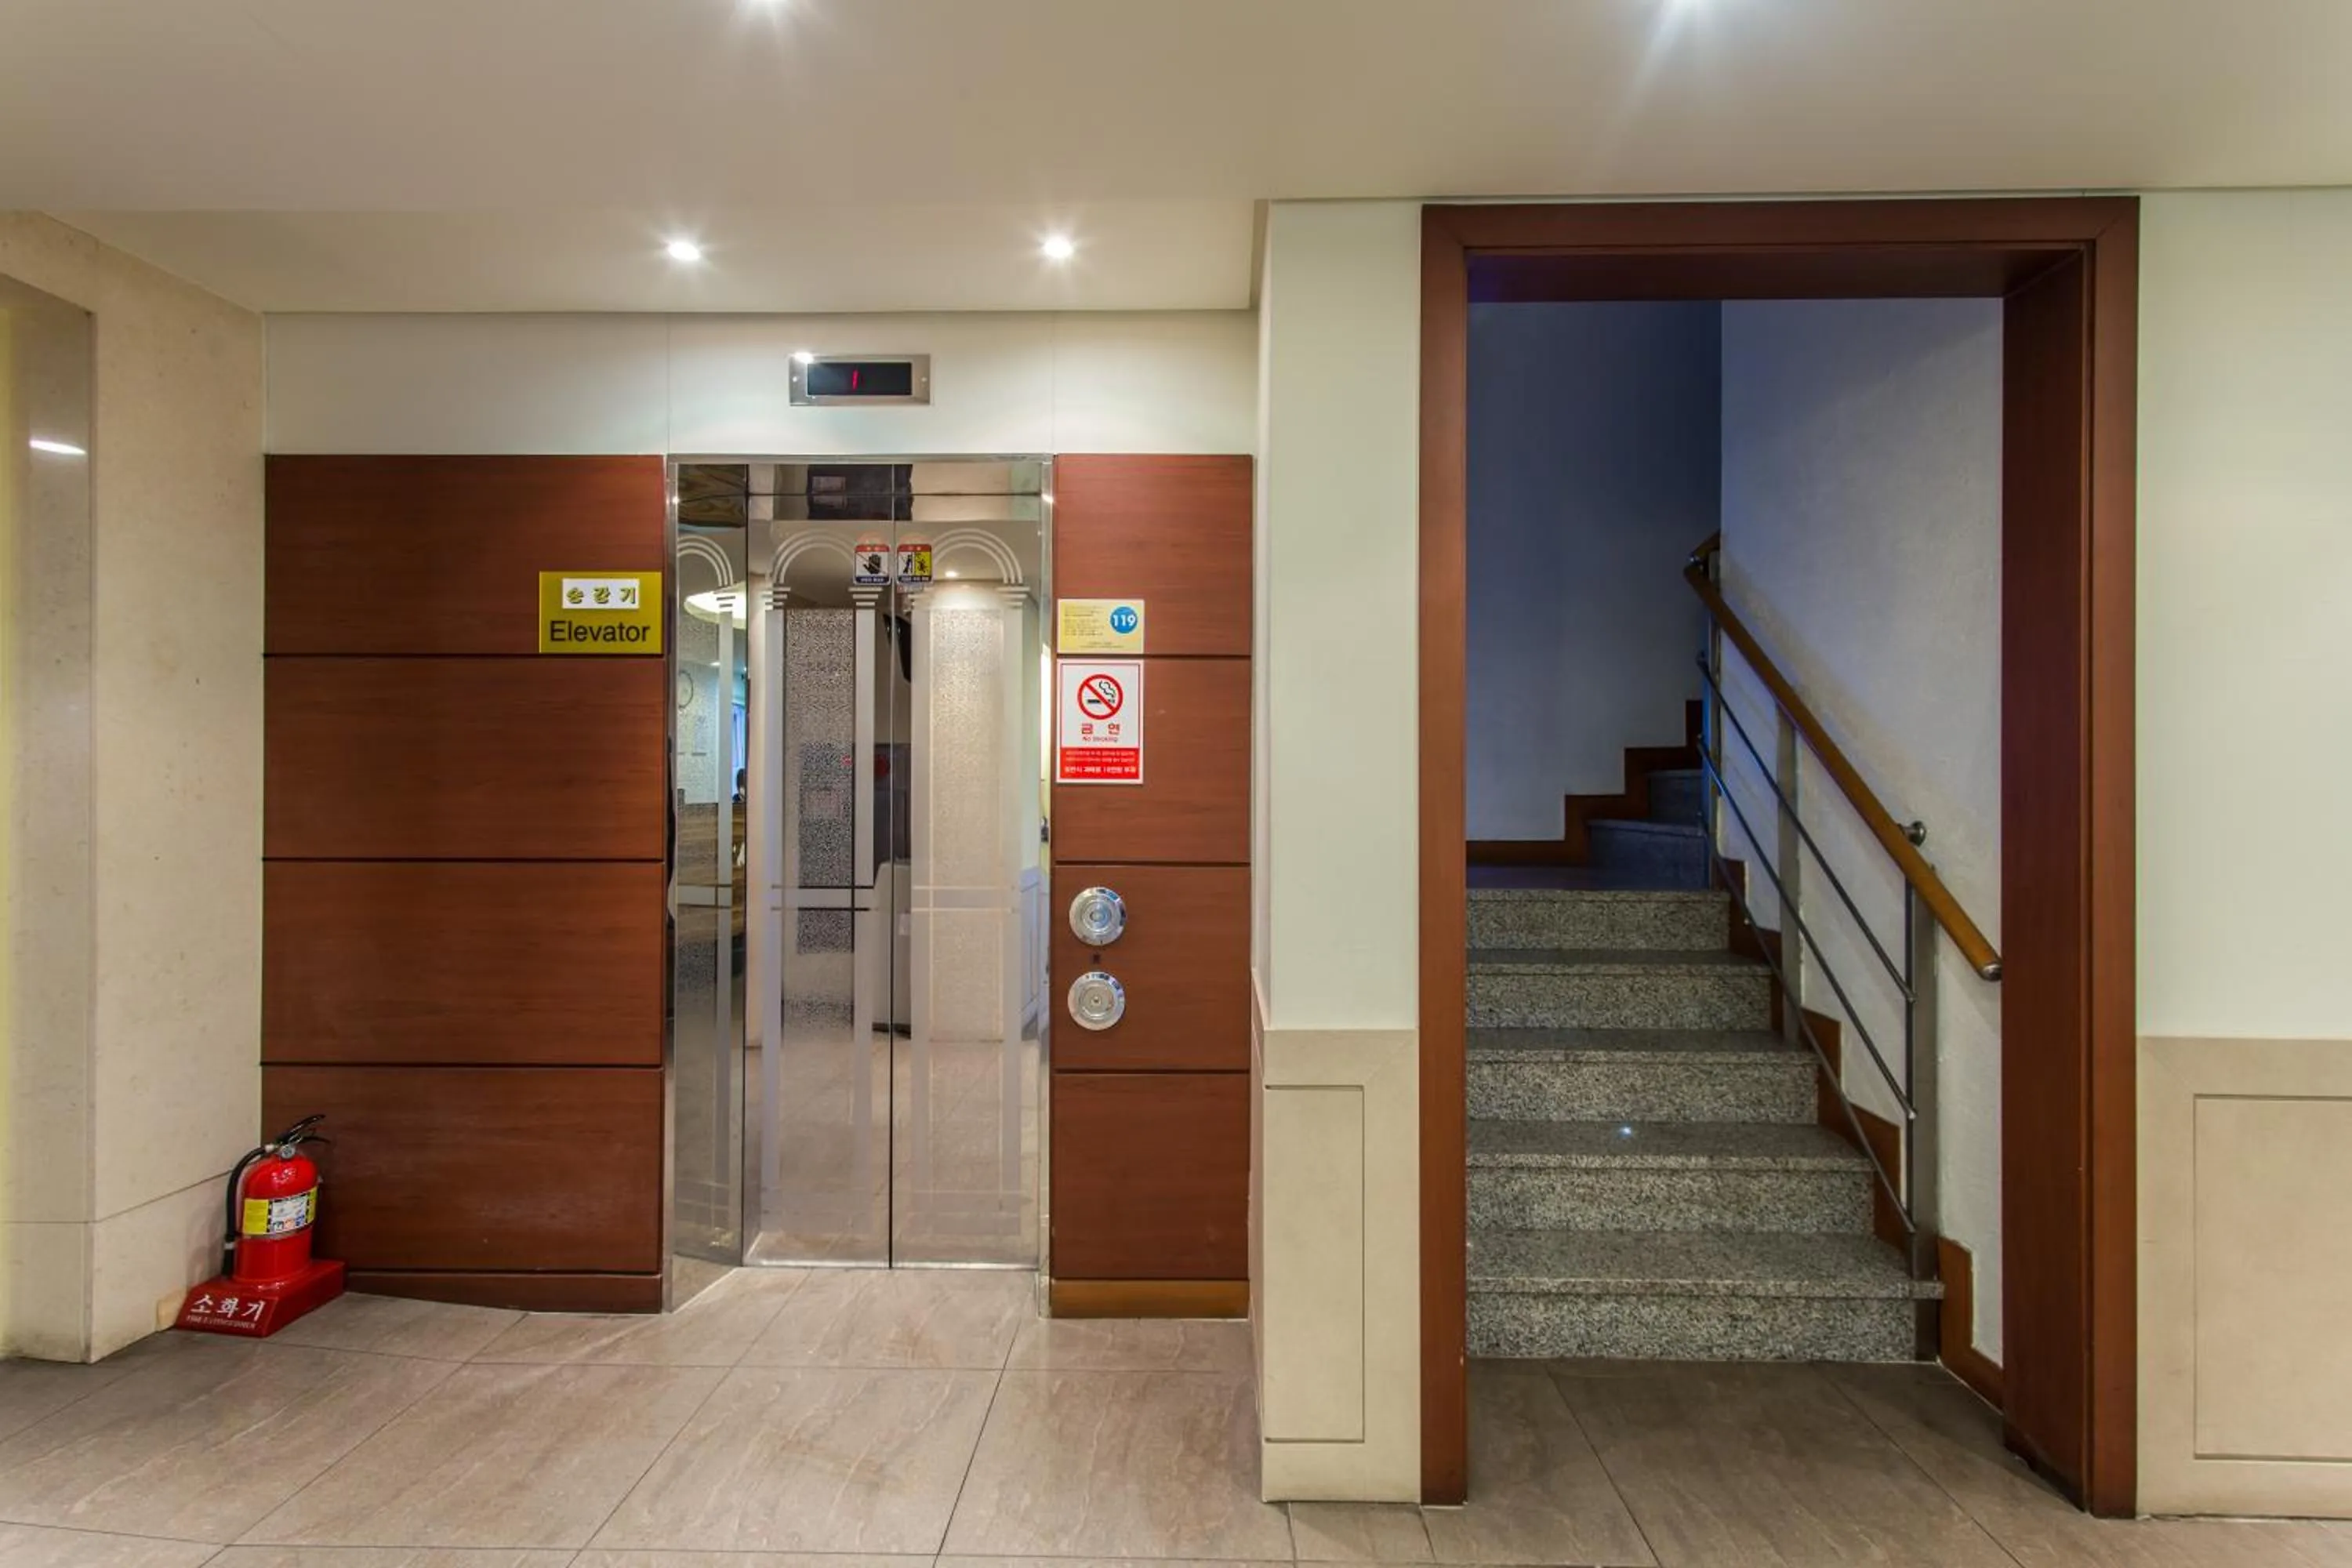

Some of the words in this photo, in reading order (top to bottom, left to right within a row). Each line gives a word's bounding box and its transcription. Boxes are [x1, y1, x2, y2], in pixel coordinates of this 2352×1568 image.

[566, 586, 637, 605] 승강기
[1113, 614, 1136, 626] 119
[550, 620, 651, 643] Elevator
[191, 1294, 266, 1322] 소화기
